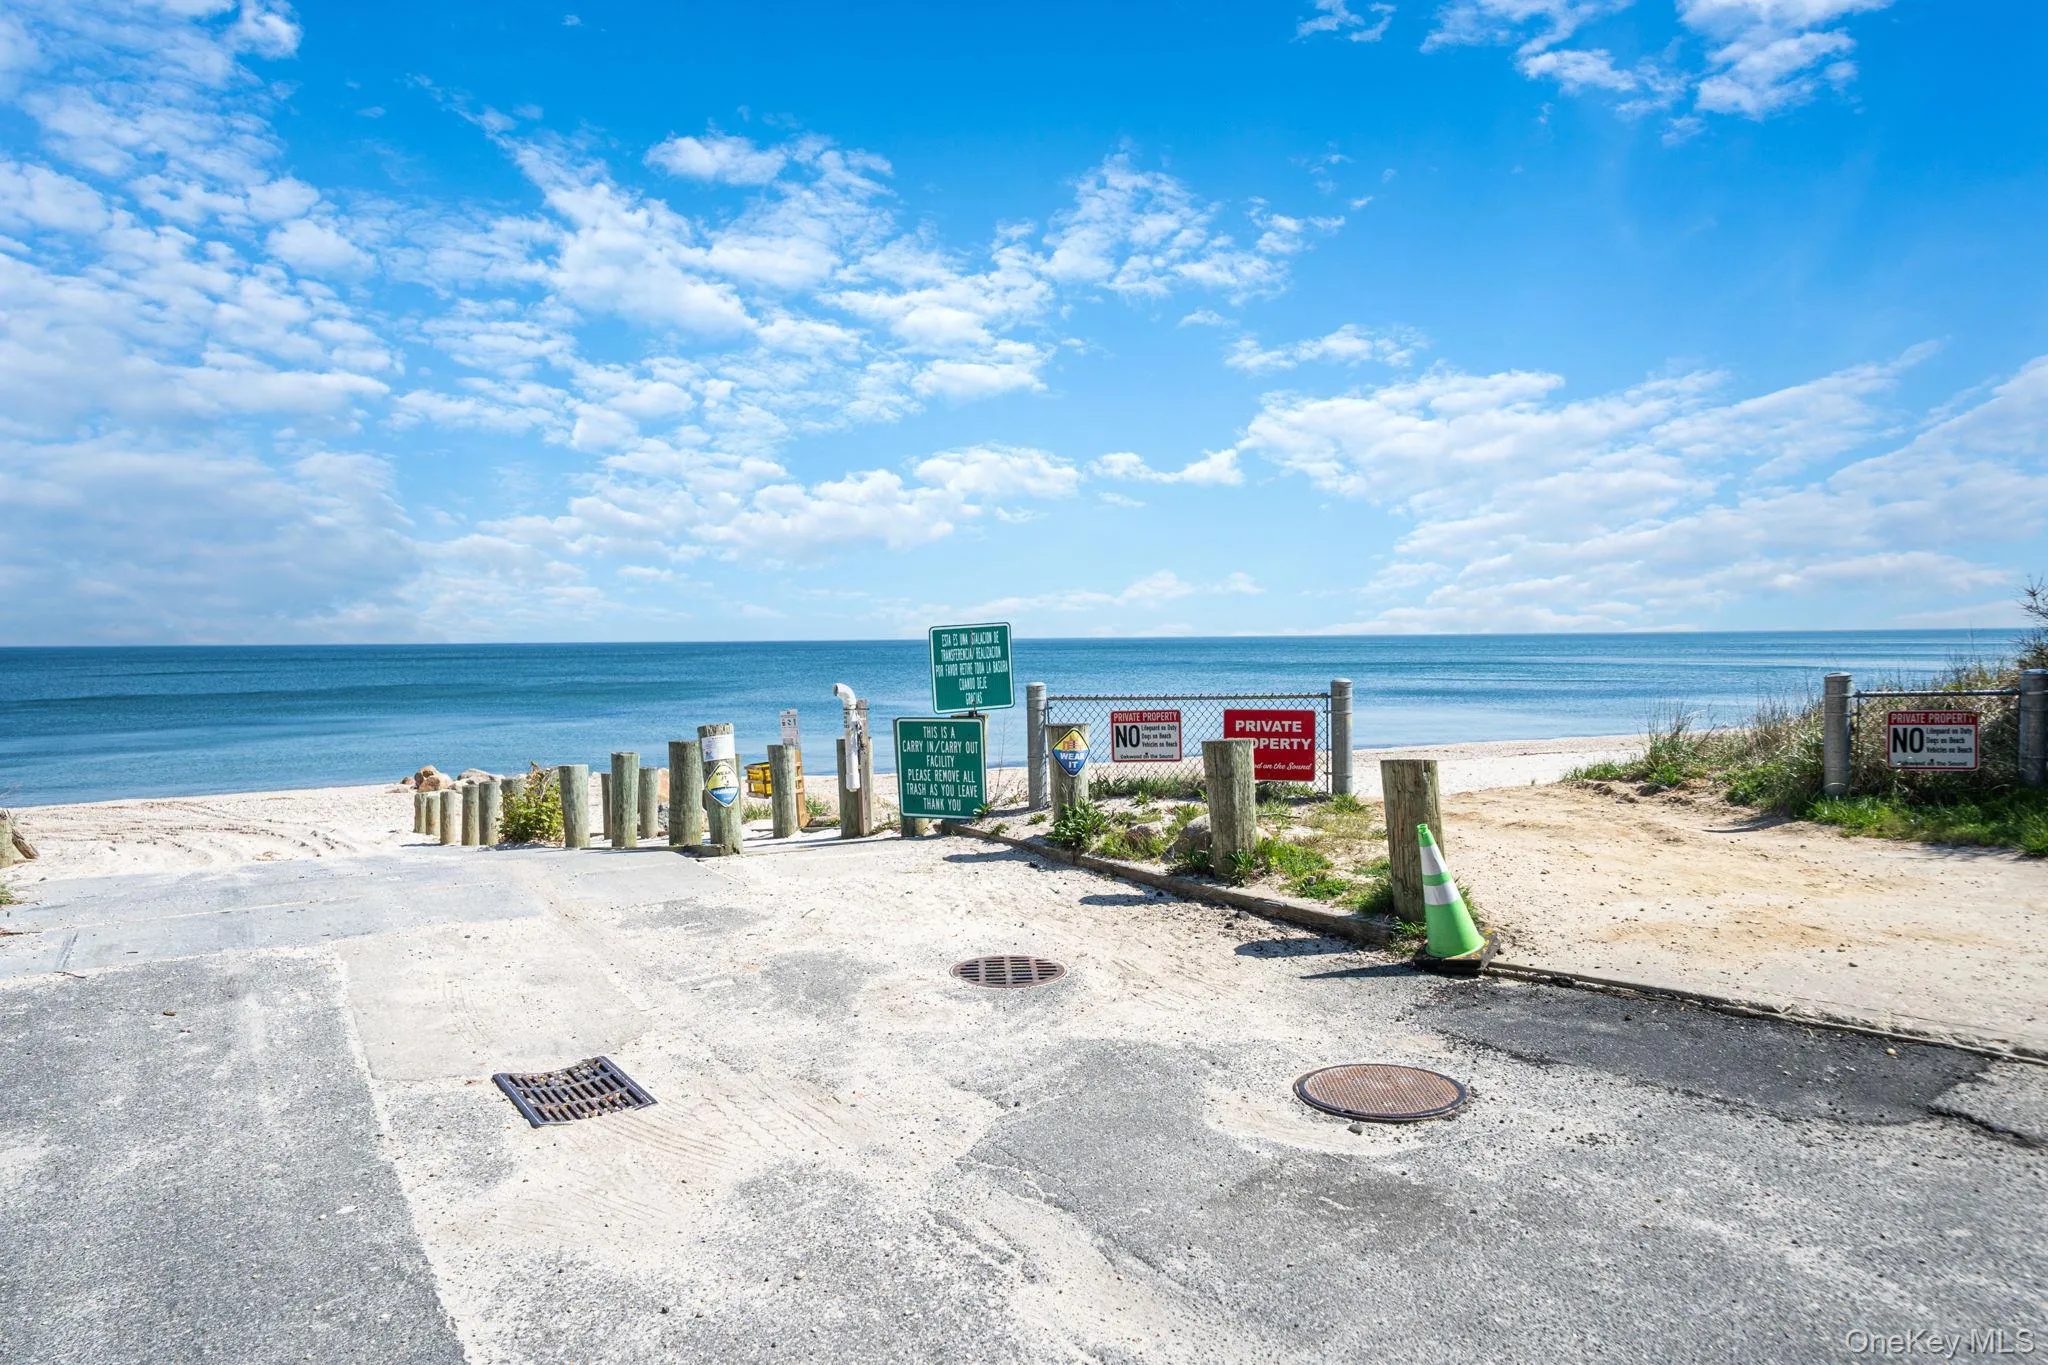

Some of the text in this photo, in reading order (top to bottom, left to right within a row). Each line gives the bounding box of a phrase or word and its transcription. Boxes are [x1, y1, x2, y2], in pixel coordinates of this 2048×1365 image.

[942, 634, 952, 647] ESTA
[953, 634, 958, 646] ES
[960, 633, 968, 646] UNA
[994, 631, 999, 643] DE
[945, 664, 958, 676] FAVOR
[960, 663, 973, 675] RETIRE
[974, 662, 985, 674] TODA
[986, 662, 992, 674] LA
[993, 660, 1008, 673] BASURA
[959, 676, 987, 690] CUANDO DEJE
[966, 692, 982, 705] GRACIAS
[1114, 712, 1178, 722] PRIVATE PROPERTY
[1892, 713, 1972, 723] PRIVATE PROPERTY
[923, 726, 955, 739] THIS IS A
[1235, 720, 1302, 732] PRIVATE
[1115, 725, 1140, 748] NO
[1892, 728, 1924, 753] NO
[902, 740, 978, 754] CARRY IN/CARRY OUT
[1253, 738, 1312, 750] OPERTY
[926, 755, 954, 767] FACILITY
[1287, 762, 1312, 770] Sound
[908, 769, 975, 783] PLEASE REMOVE ALL
[906, 783, 978, 797] TRASH AS YOU LEAVE
[923, 798, 961, 811] THANK YOU
